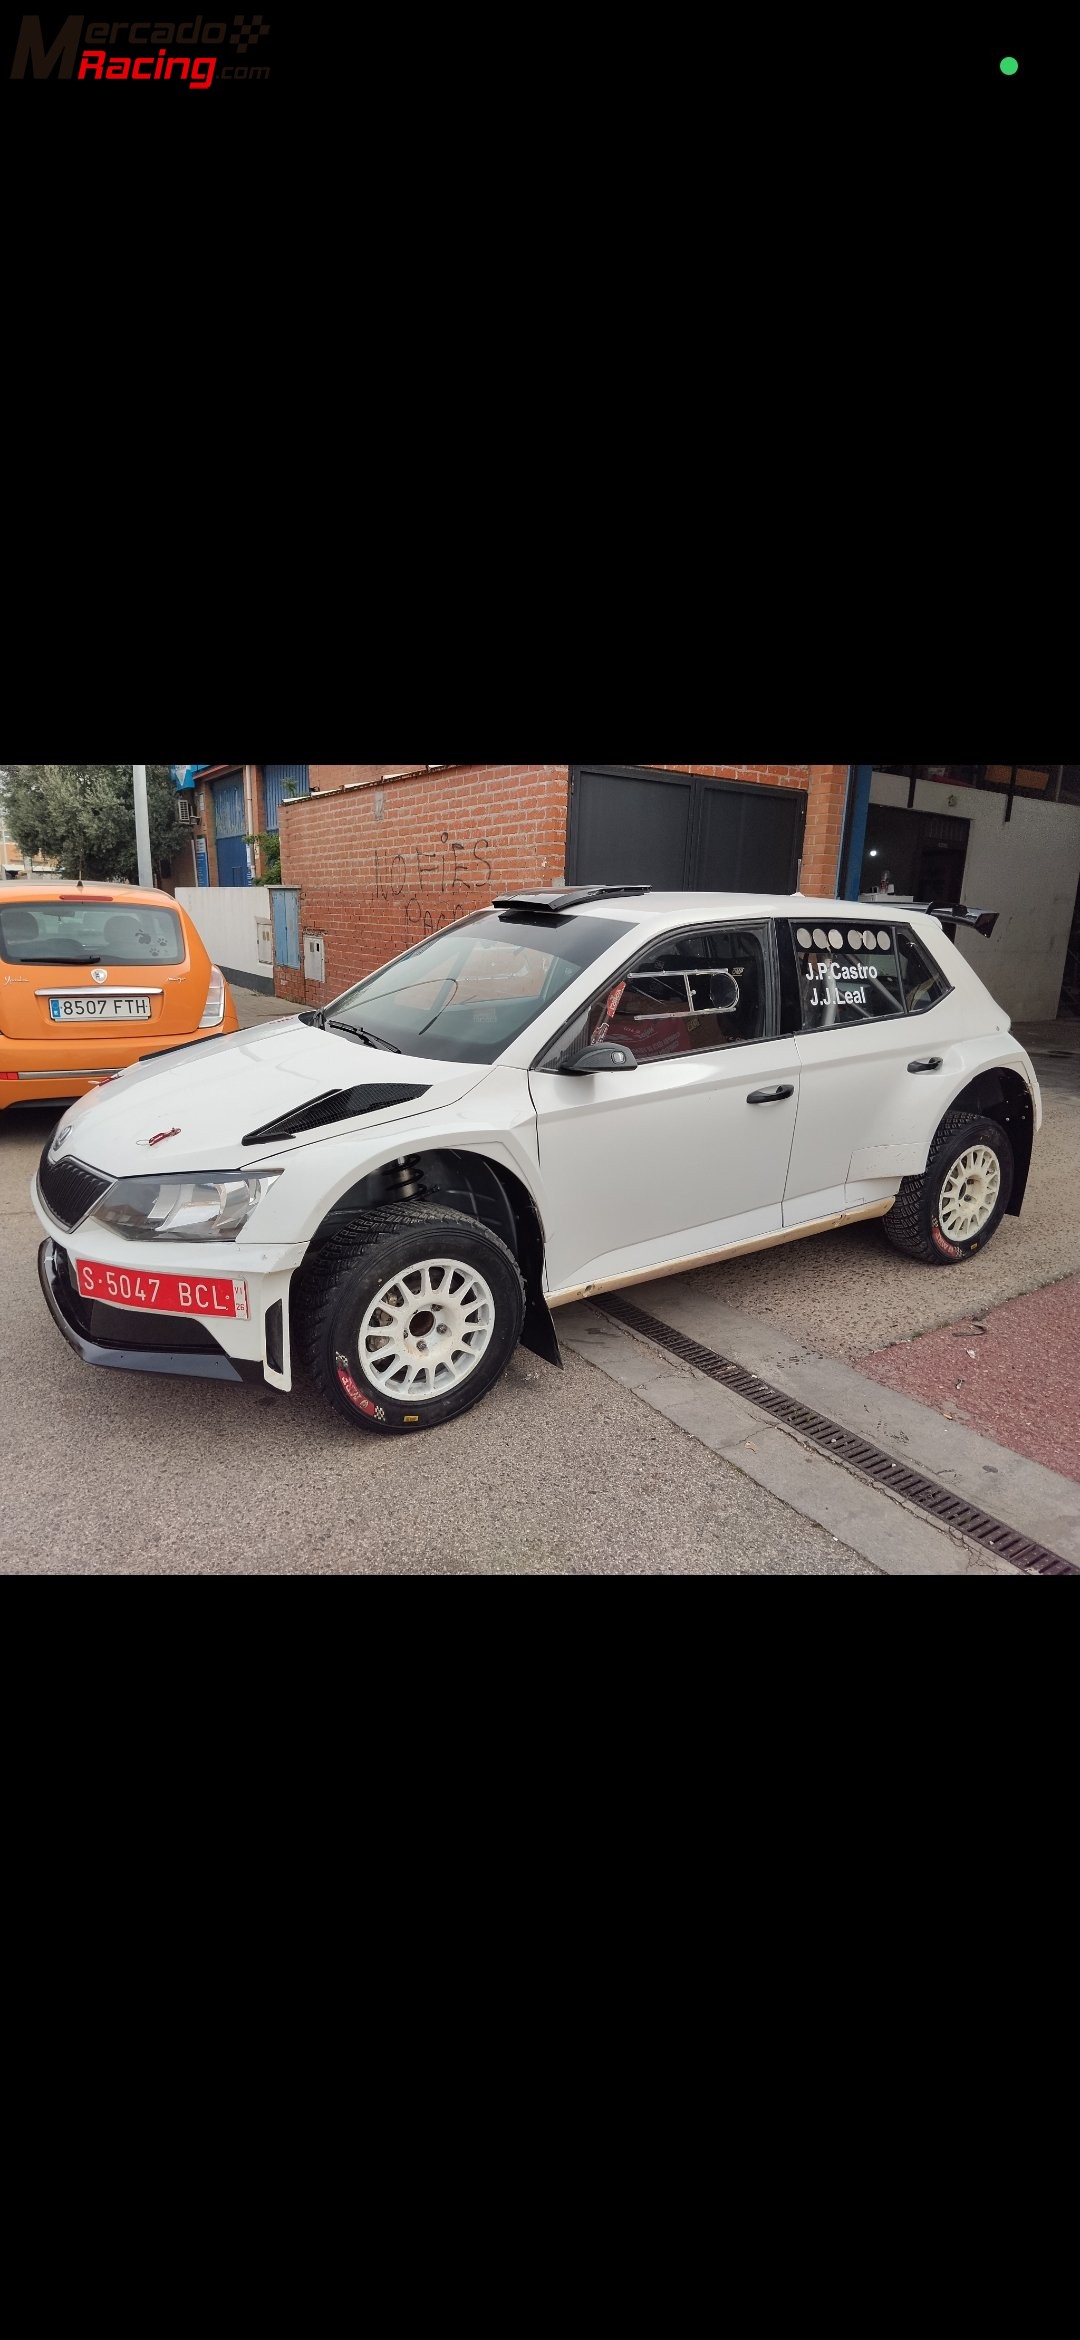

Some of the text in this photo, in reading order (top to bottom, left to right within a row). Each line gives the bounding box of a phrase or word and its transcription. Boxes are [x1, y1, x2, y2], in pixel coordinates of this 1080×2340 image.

[805, 962, 878, 981] J.P.Castro
[810, 986, 867, 1006] J.J.Leal
[63, 999, 146, 1015] 8507 FTH
[178, 1282, 227, 1311] BCL
